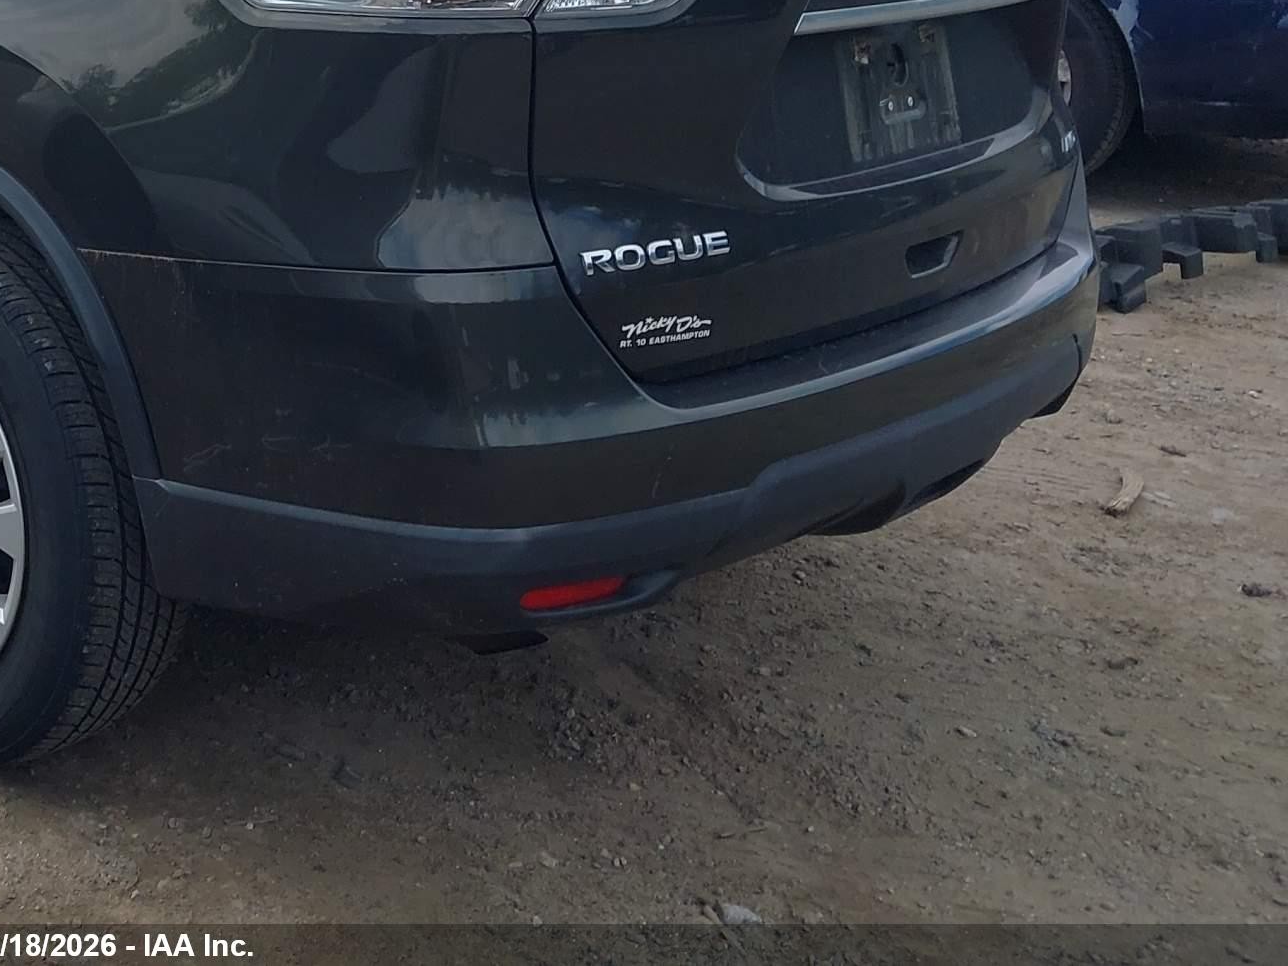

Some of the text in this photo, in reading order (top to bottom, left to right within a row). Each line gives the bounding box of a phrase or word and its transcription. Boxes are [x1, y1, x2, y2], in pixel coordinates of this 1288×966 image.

[580, 231, 731, 276] ROGUE
[619, 330, 710, 348] RT. 10 EASTHAMPTON
[621, 315, 712, 339] Nicky D's
